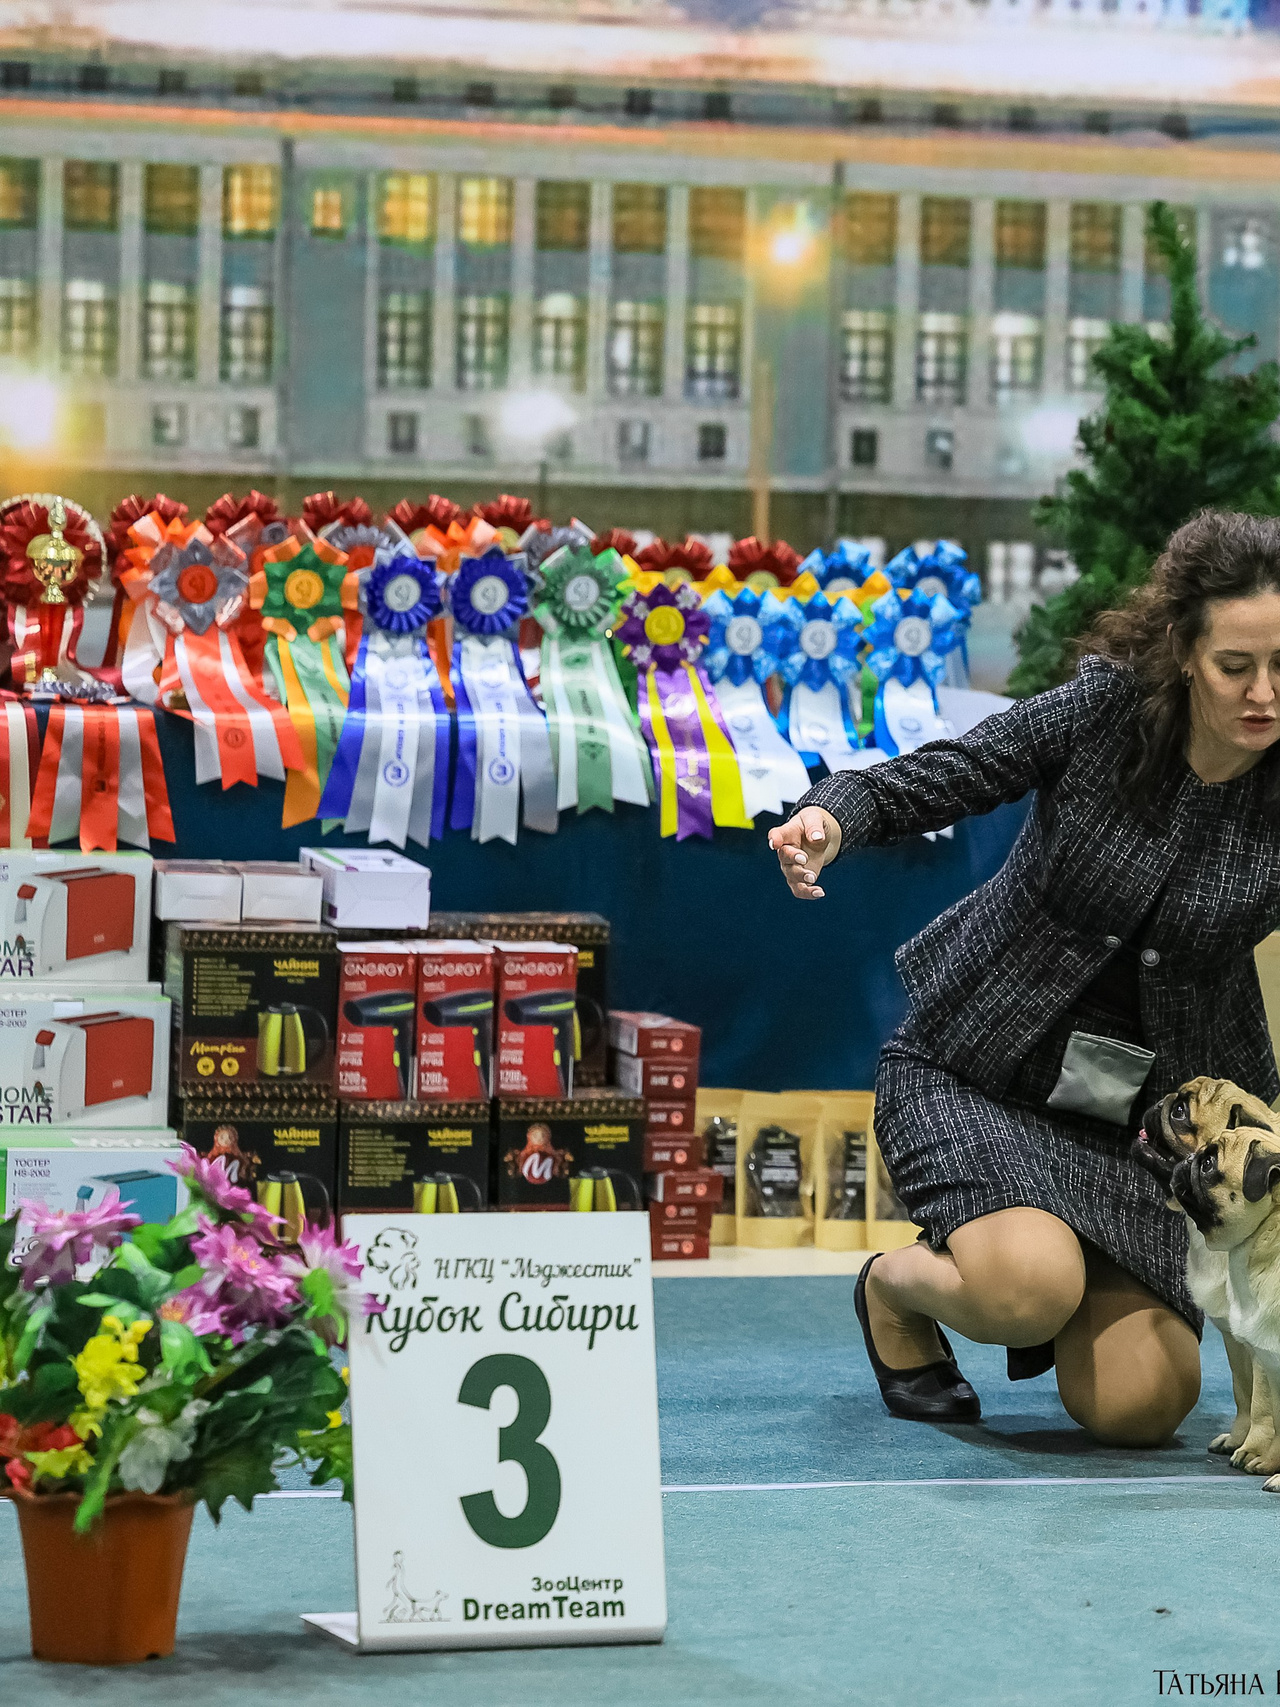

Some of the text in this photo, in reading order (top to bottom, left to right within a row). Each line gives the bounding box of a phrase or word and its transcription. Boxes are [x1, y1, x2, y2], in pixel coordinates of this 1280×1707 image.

[344, 962, 404, 977] ENERGY
[422, 962, 483, 977] ENERGY
[504, 961, 565, 976] ENERGY
[0, 1086, 54, 1104] OME
[0, 1104, 53, 1124] TAR
[434, 1257, 495, 1284] НГКЦ
[365, 1291, 640, 1353] Кубок Сибири
[457, 1353, 562, 1549] 3
[531, 1576, 624, 1594] ЗооЦентр
[463, 1595, 626, 1621] DreamTeam
